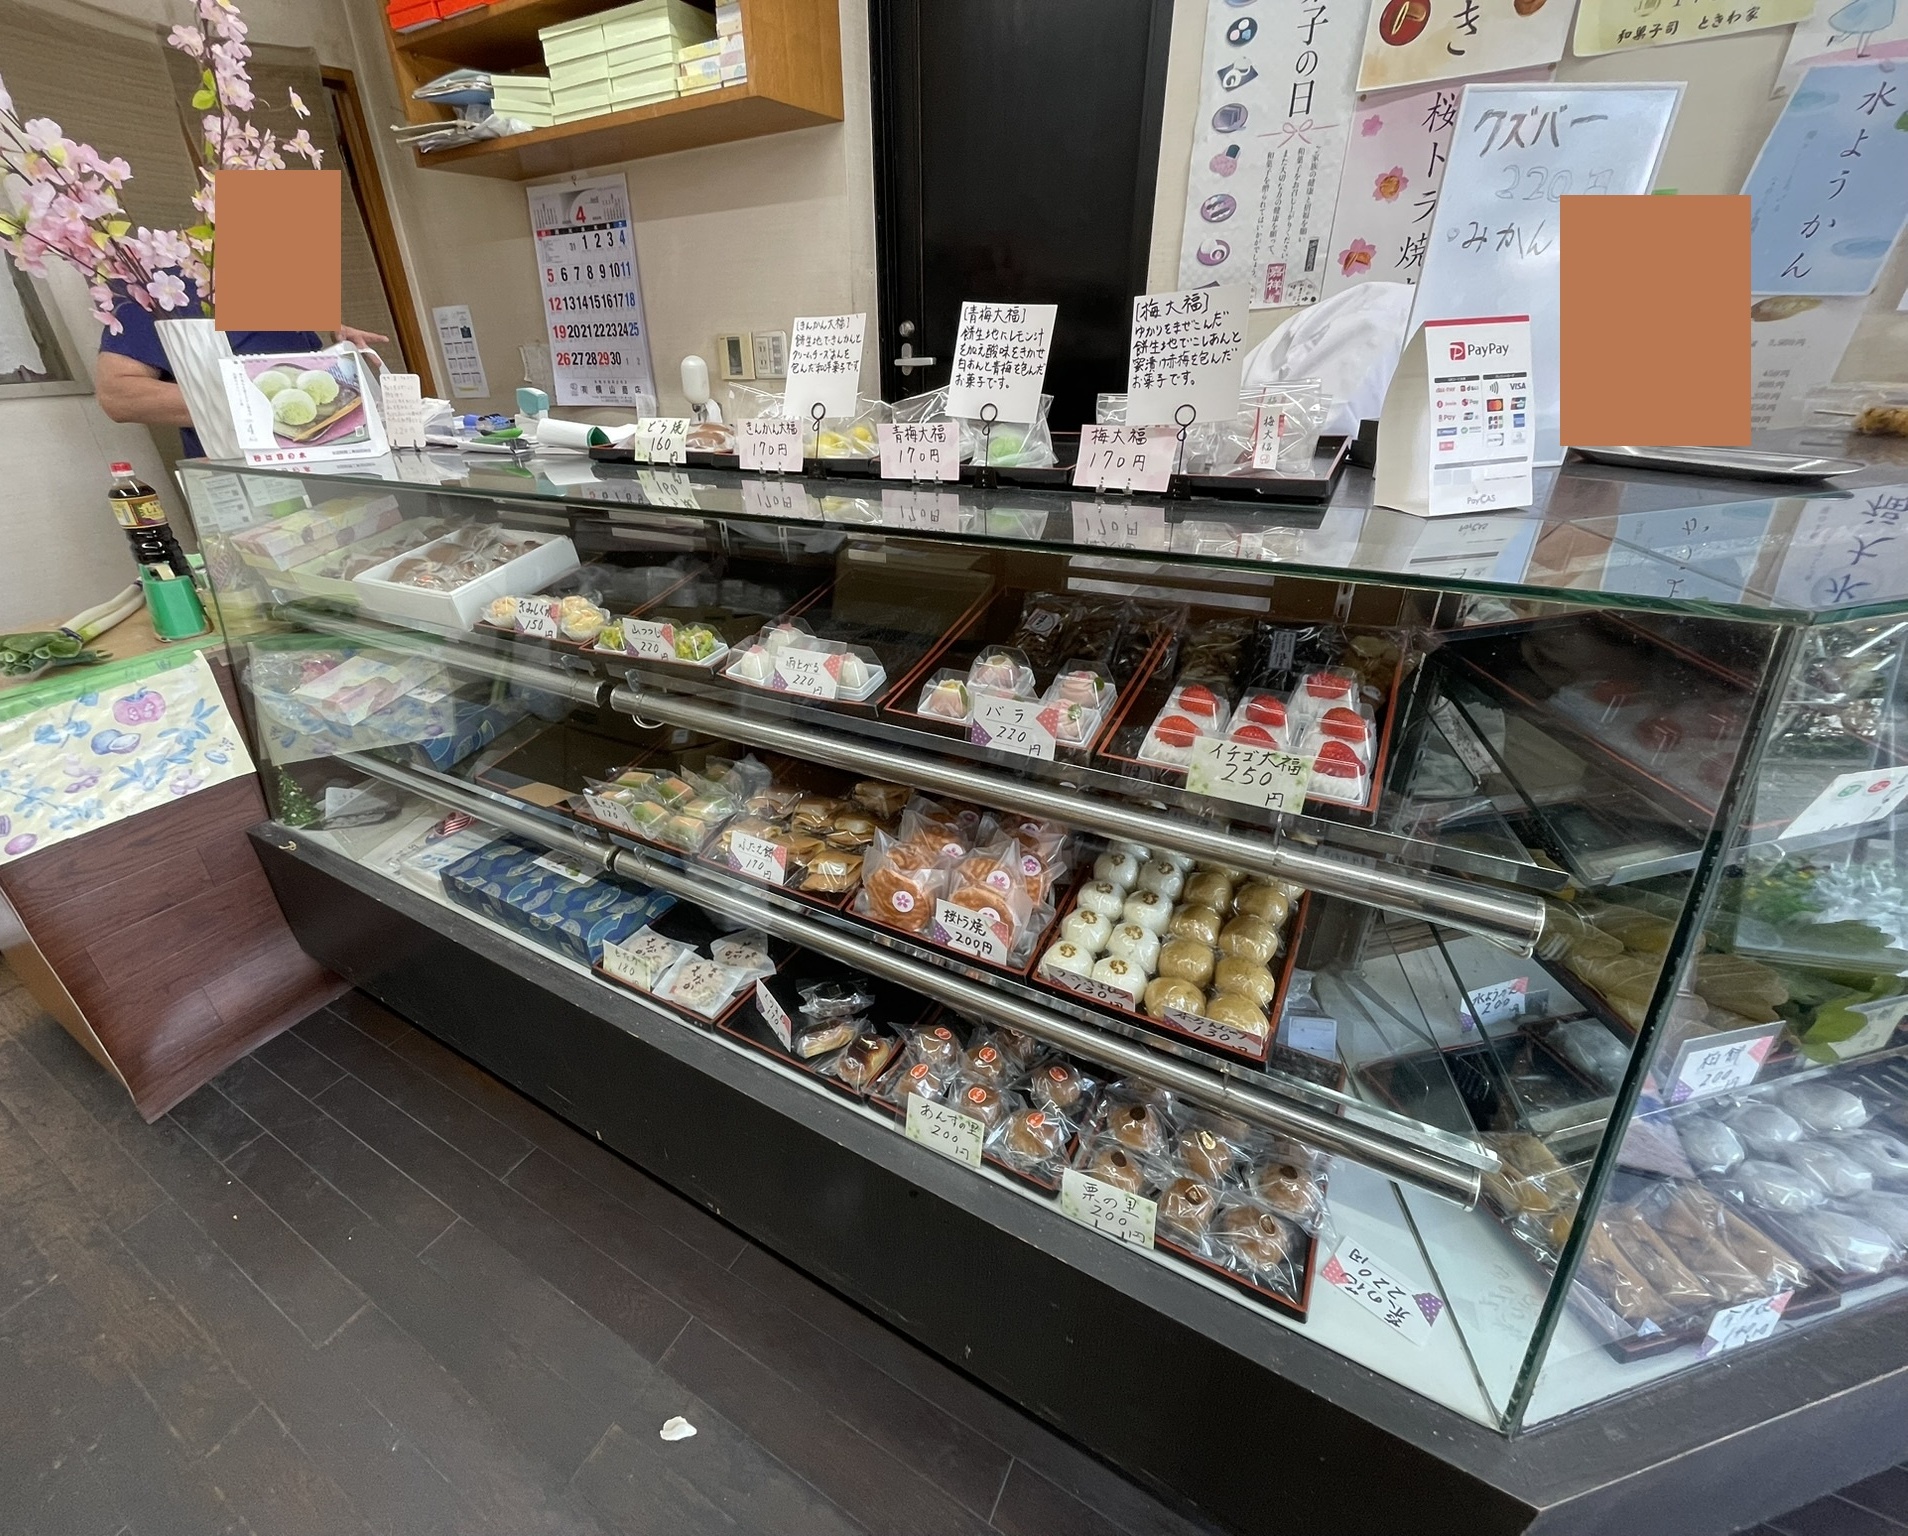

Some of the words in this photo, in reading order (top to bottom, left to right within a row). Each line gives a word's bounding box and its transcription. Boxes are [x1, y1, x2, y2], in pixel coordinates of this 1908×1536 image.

[1617, 20, 1680, 44] 和菓子司
[1697, 6, 1760, 30] ときわ家
[1288, 0, 1328, 117] 子の日
[1474, 104, 1608, 158] クズバー
[1394, 92, 1456, 284] 桜トラ焼
[1781, 81, 1896, 278] 水ようかん
[576, 206, 586, 223] 4
[582, 234, 588, 249] 1
[594, 233, 601, 248] 2
[606, 231, 614, 247] 3
[619, 230, 626, 245] 4
[1462, 219, 1553, 259] みかん
[547, 268, 554, 283] 5
[561, 267, 568, 282] 6
[574, 266, 580, 280] 7
[587, 265, 593, 279] 8
[599, 264, 606, 279] 9
[609, 262, 620, 278] 10
[621, 261, 631, 277] 11
[549, 297, 562, 311] 12
[562, 296, 576, 310] 13
[576, 295, 589, 310] 14
[588, 294, 601, 309] 15
[601, 294, 613, 308] 16
[613, 293, 624, 307] 17
[625, 292, 636, 307] 18
[553, 325, 567, 339] 19
[567, 324, 580, 339] 20
[580, 324, 593, 338] 21
[593, 323, 606, 338] 22
[605, 322, 618, 337] 23
[617, 322, 629, 337] 24
[628, 322, 639, 336] 25
[557, 352, 571, 366] 26
[571, 352, 584, 366] 27
[584, 351, 598, 366] 28
[597, 351, 610, 365] 29
[610, 351, 621, 365] 30
[1467, 342, 1510, 358] PayPay
[1509, 382, 1526, 391] VISA
[646, 418, 685, 435] どら焼
[745, 420, 799, 437] きんかん大福
[892, 425, 946, 444] 青梅大福
[1091, 426, 1147, 446] 梅大福
[650, 437, 671, 452] 160
[752, 443, 788, 457] 170円
[899, 449, 941, 465] 170円
[1089, 449, 1147, 472] 170円
[525, 619, 543, 631] 150
[640, 641, 659, 653] 220
[792, 674, 815, 687] 220
[986, 704, 1025, 725] バラ
[995, 725, 1027, 743] 220
[1029, 742, 1041, 757] 円
[1208, 743, 1302, 777] イチゴ大福
[1220, 763, 1273, 787] 250
[1265, 792, 1285, 808] 円
[746, 859, 764, 871] 170
[954, 931, 993, 955] 200円
[1072, 983, 1107, 999] 130
[1481, 998, 1511, 1016] 200
[1192, 1023, 1231, 1042] 130
[1699, 1068, 1733, 1087] 200
[919, 1104, 980, 1138] あんずの里
[930, 1124, 959, 1143] 200
[955, 1144, 970, 1161] 円
[1081, 1181, 1140, 1219] 栗の里
[1090, 1203, 1129, 1227] 200
[1358, 1268, 1407, 1300] 220
[1340, 1273, 1411, 1328] 菜の花
